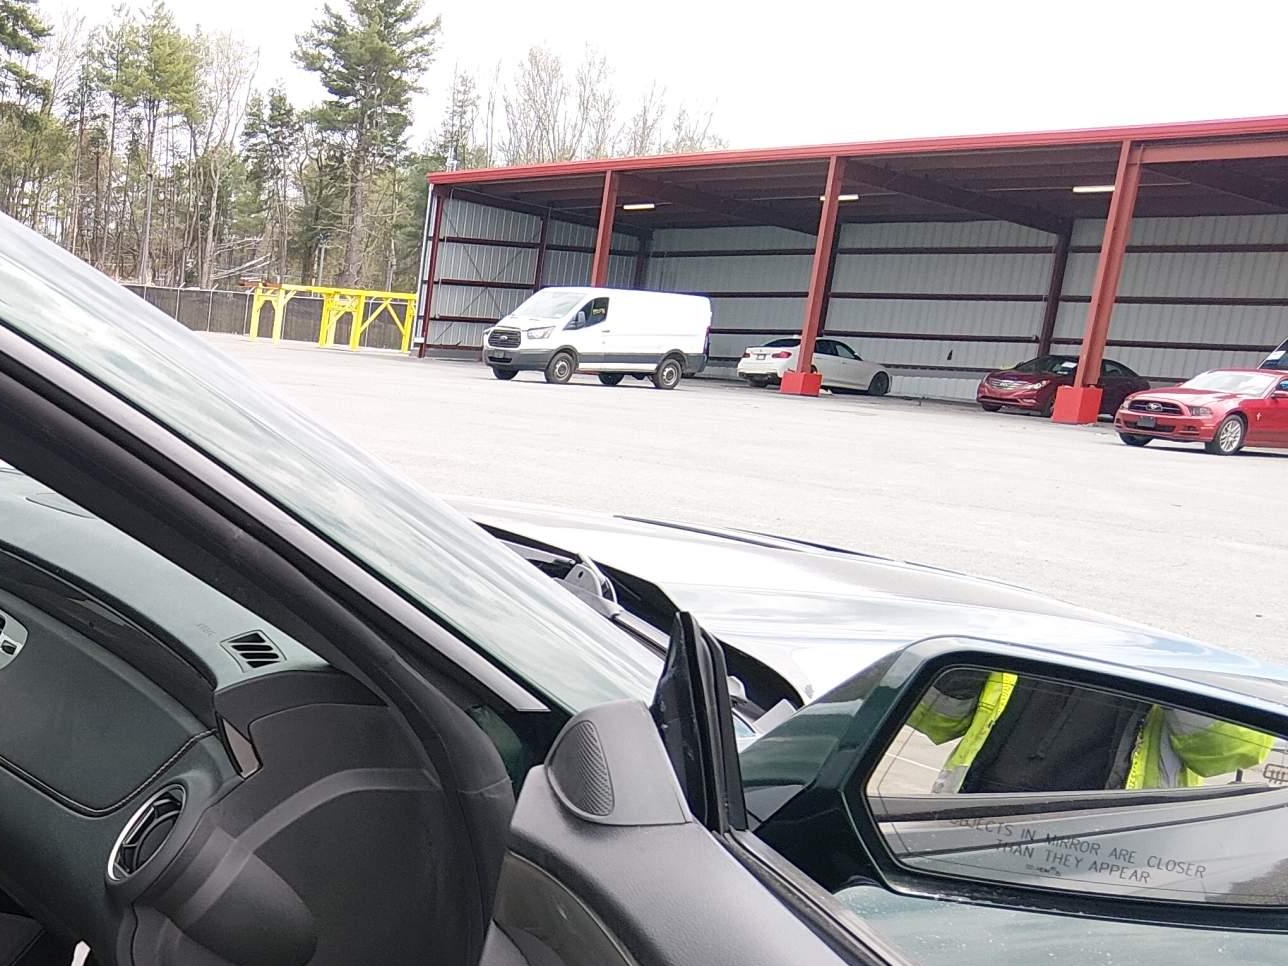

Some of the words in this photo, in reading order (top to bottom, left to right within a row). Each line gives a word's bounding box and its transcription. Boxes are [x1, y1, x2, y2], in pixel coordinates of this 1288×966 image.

[996, 839, 1034, 859] THAN
[1045, 850, 1083, 868] THEY
[1088, 861, 1150, 884] APPEAR
[1020, 828, 1036, 841] IN
[1046, 833, 1101, 855] MIRROR
[1108, 847, 1137, 864] ARE
[1146, 855, 1207, 879] CLOSER
